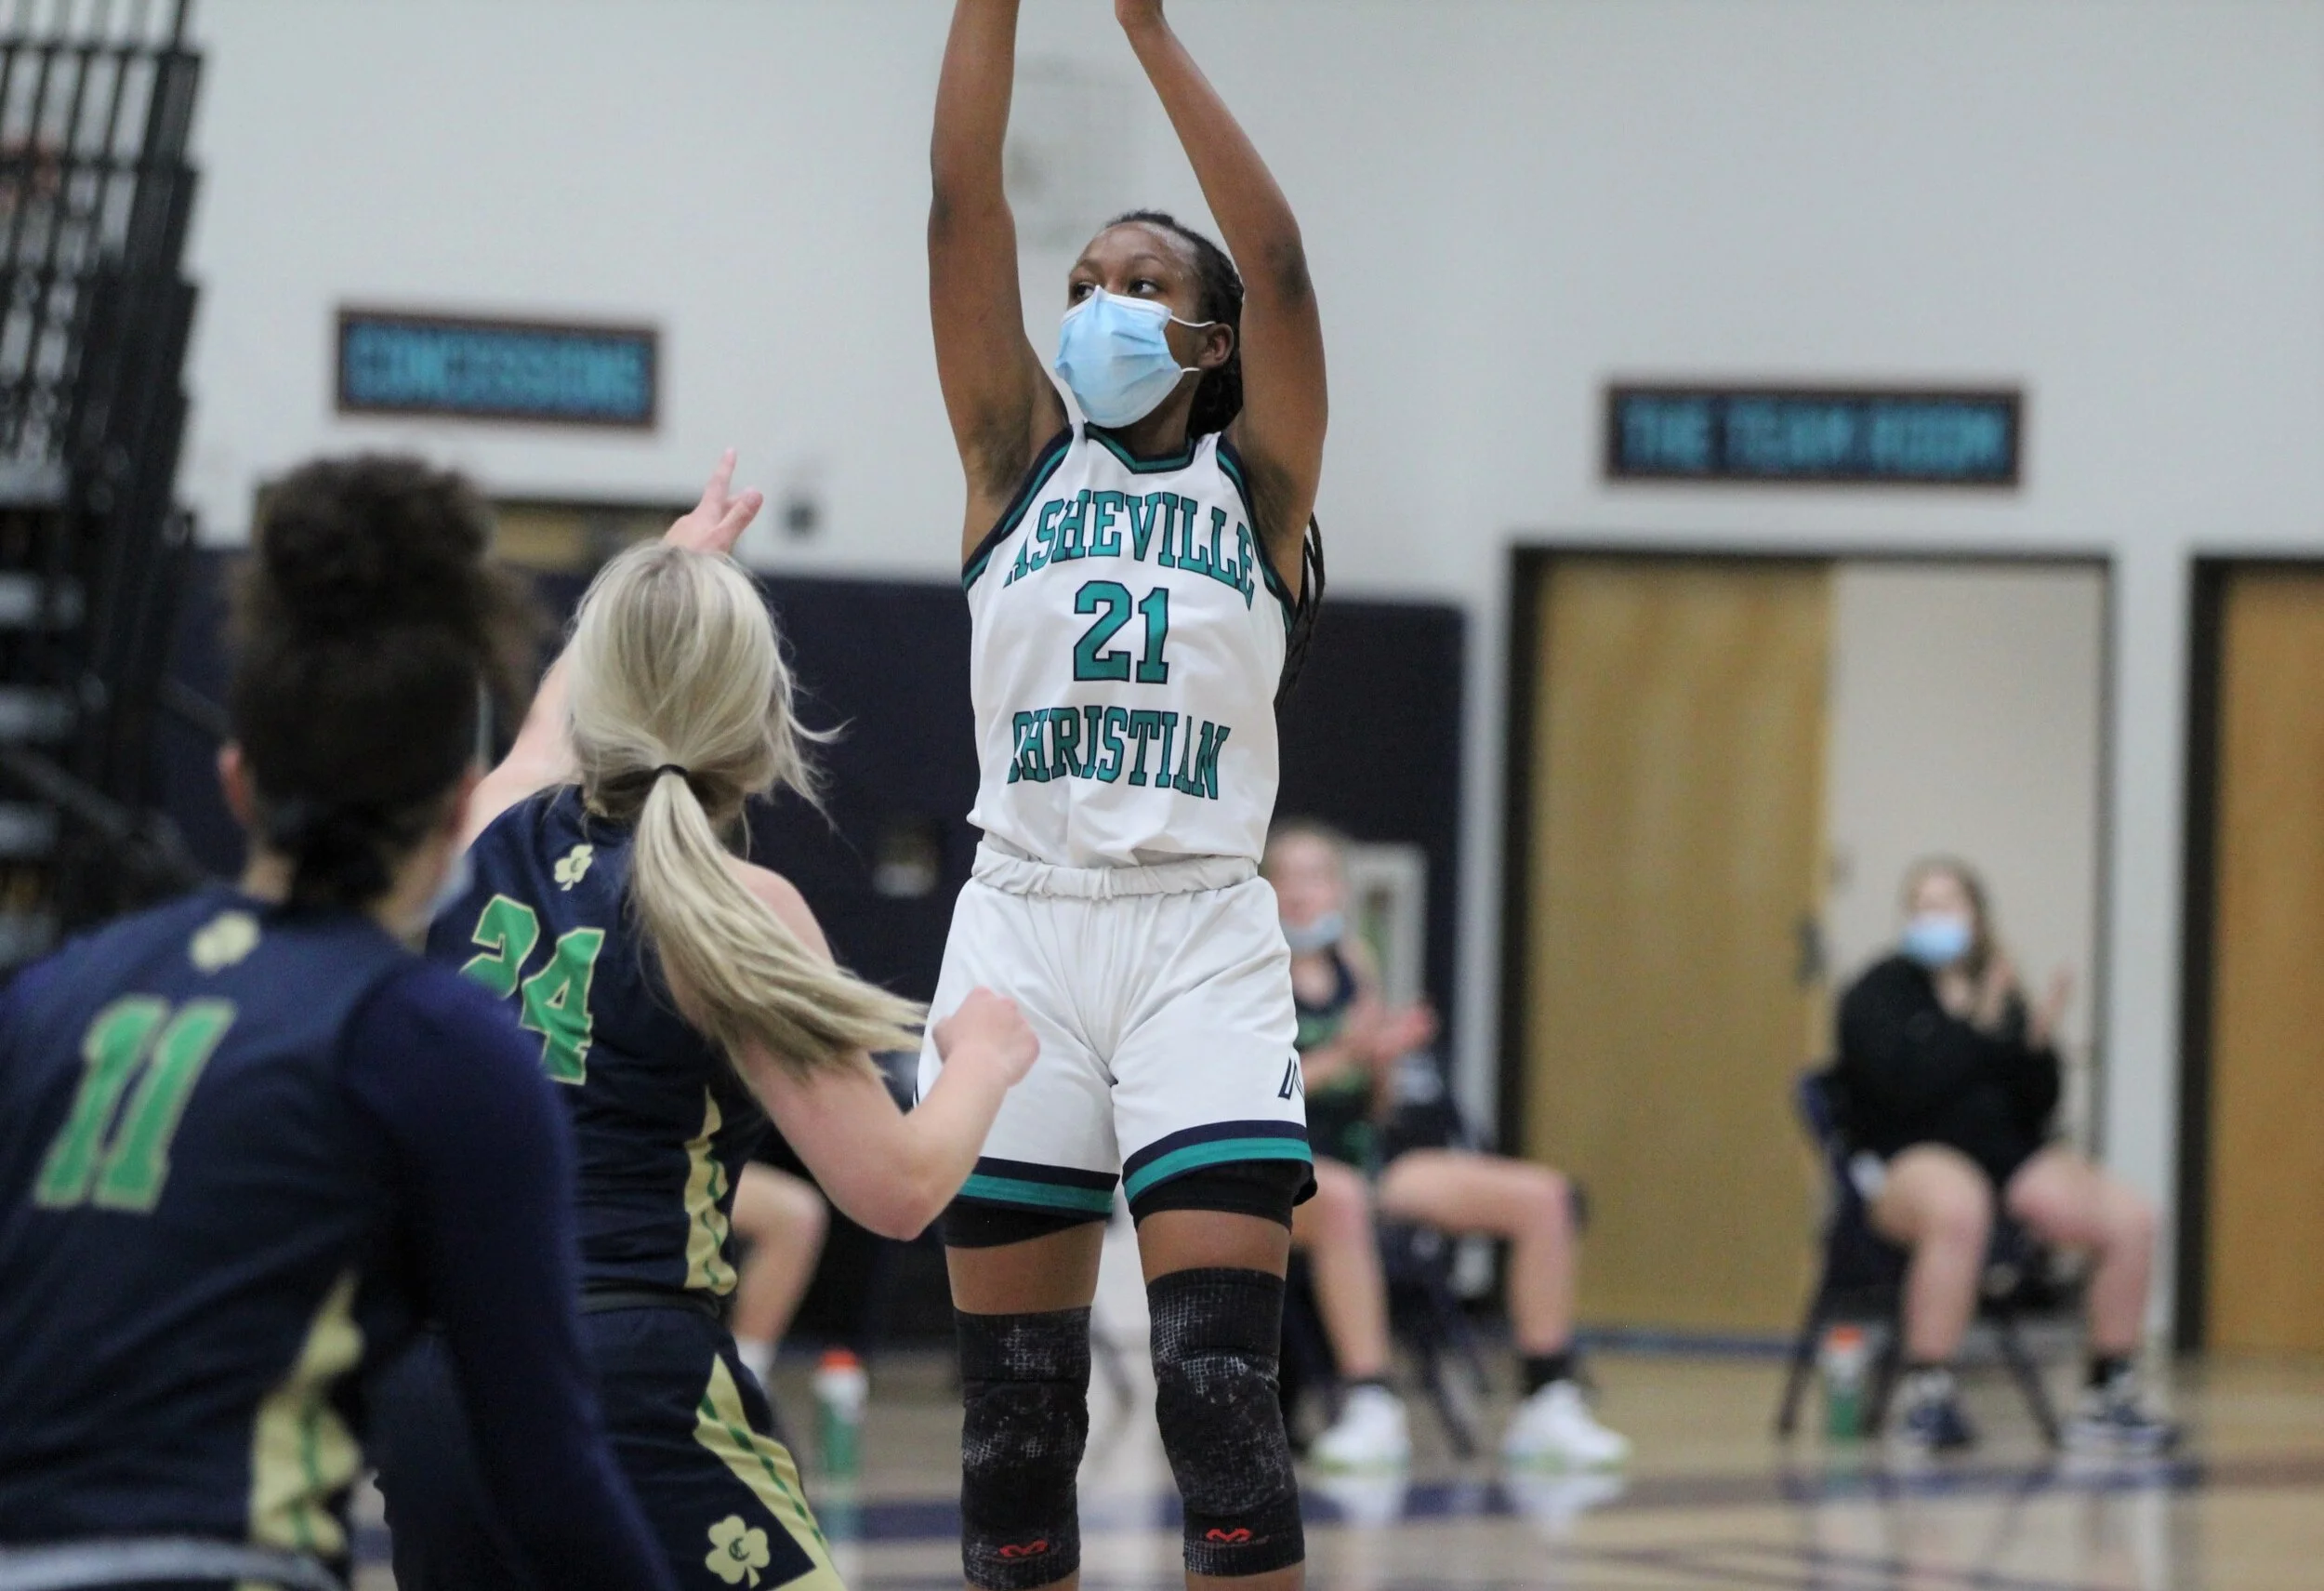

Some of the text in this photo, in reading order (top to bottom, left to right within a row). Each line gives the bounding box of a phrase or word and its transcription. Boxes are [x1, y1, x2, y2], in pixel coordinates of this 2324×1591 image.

[1074, 580, 1169, 684] 21
[458, 894, 605, 1086] 24
[33, 993, 238, 1214] 11
